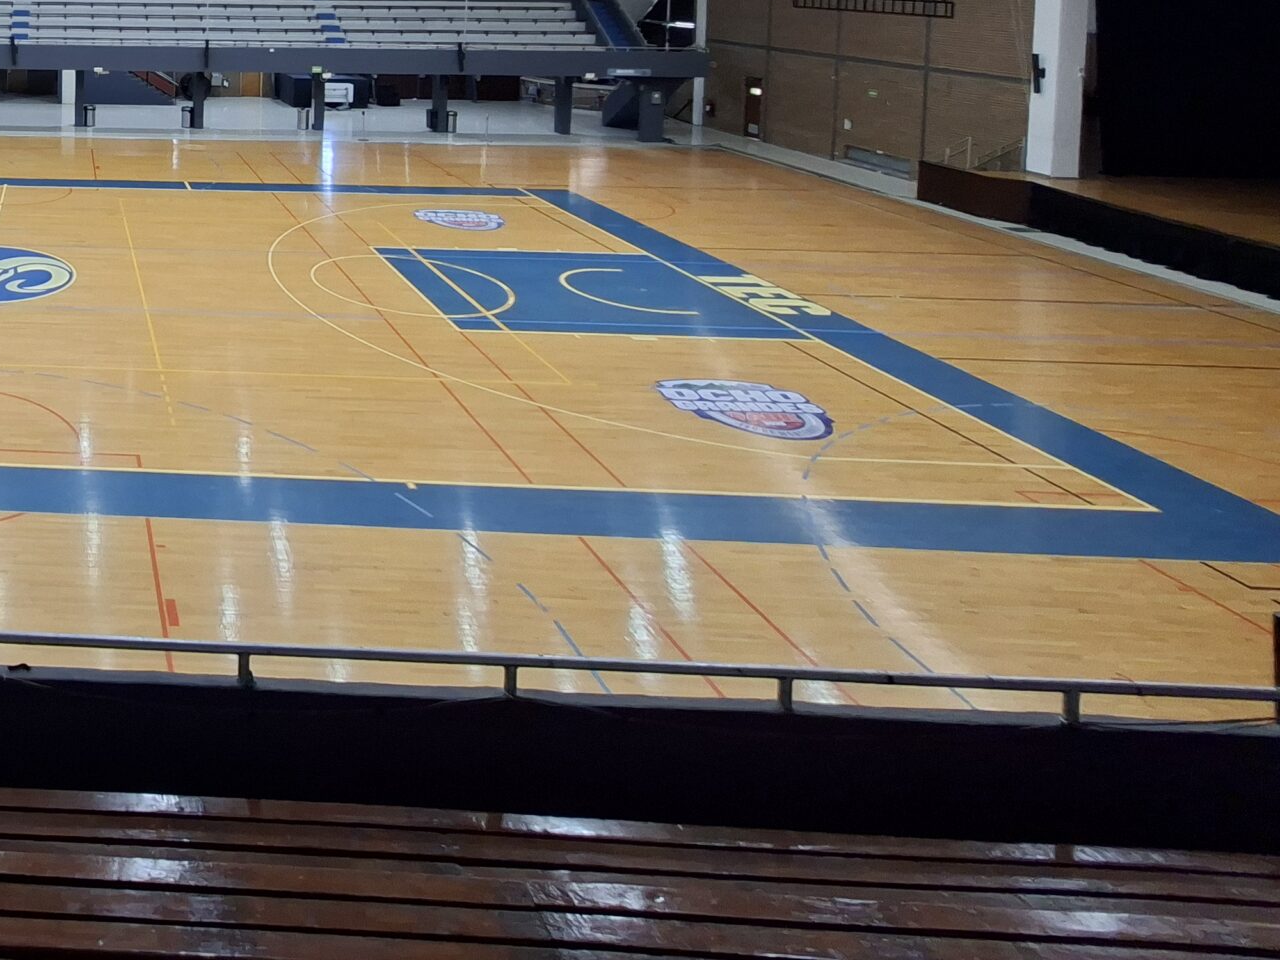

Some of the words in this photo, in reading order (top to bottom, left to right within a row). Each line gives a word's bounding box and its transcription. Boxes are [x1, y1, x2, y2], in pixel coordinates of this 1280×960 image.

[696, 274, 831, 315] TEC
[656, 387, 809, 403] OCHO
[672, 400, 826, 414] GRANDES
